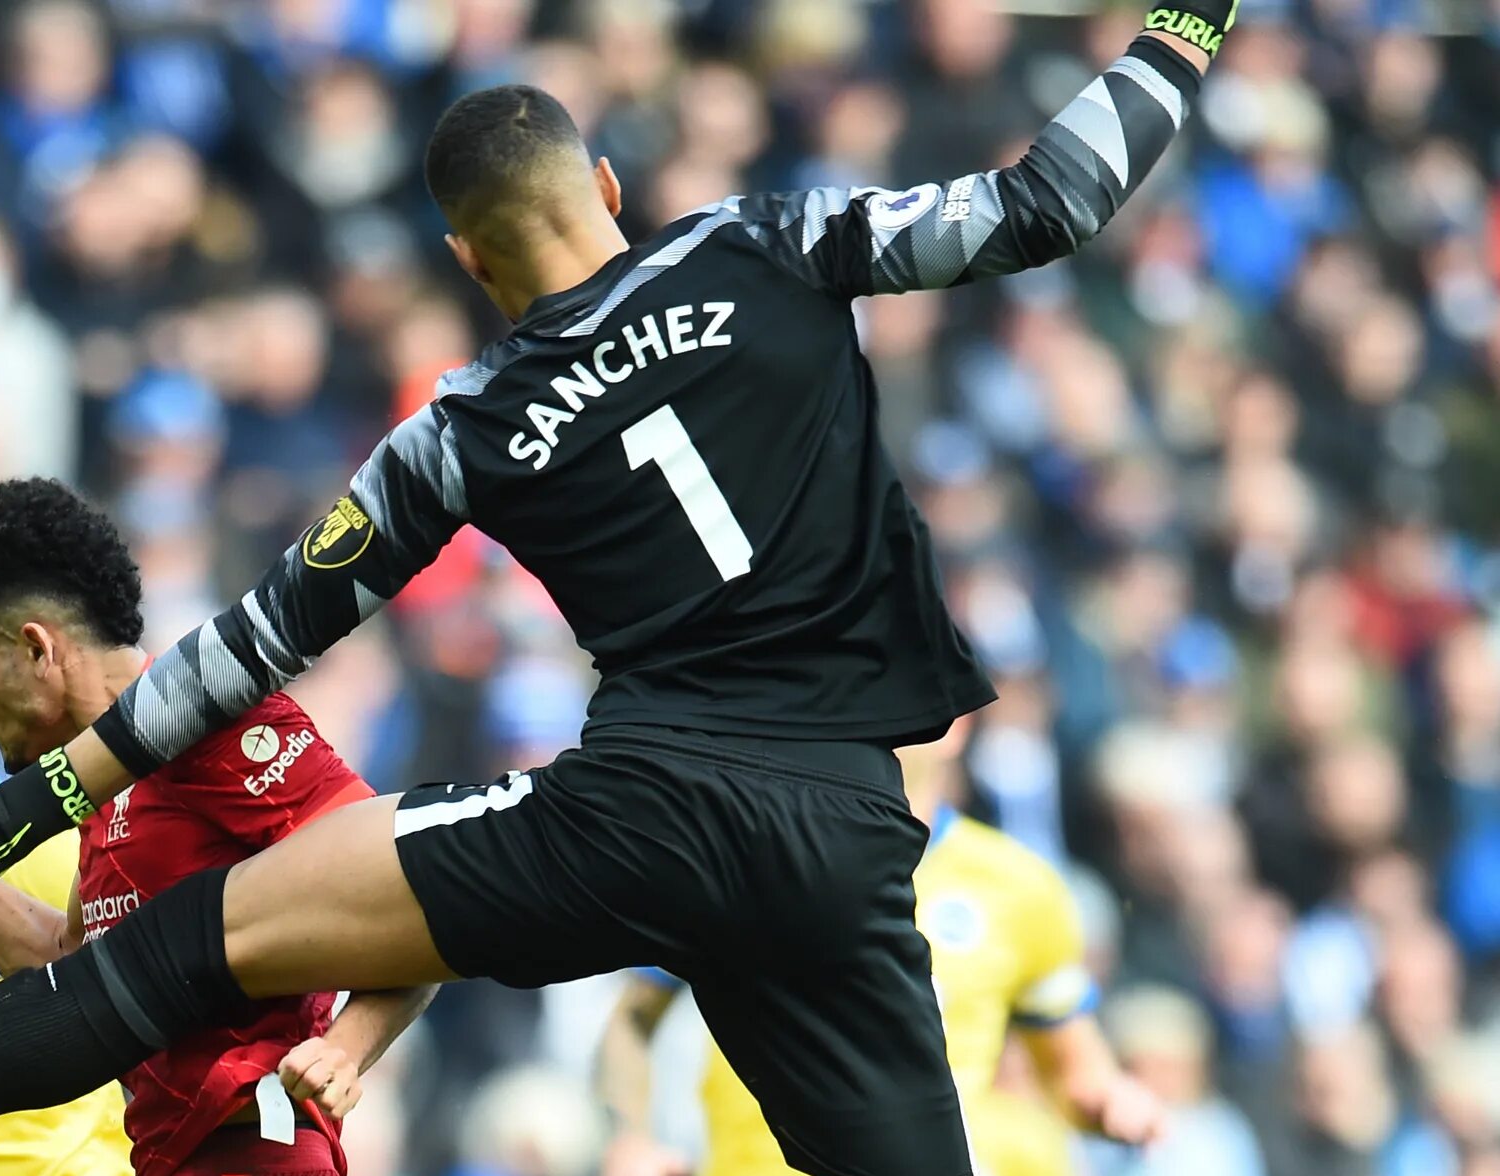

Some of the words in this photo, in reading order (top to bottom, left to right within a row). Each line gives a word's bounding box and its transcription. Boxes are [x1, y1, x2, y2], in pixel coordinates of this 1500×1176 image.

[507, 301, 736, 471] SANCHEZ
[620, 403, 754, 582] 1
[243, 728, 315, 797] Expedia
